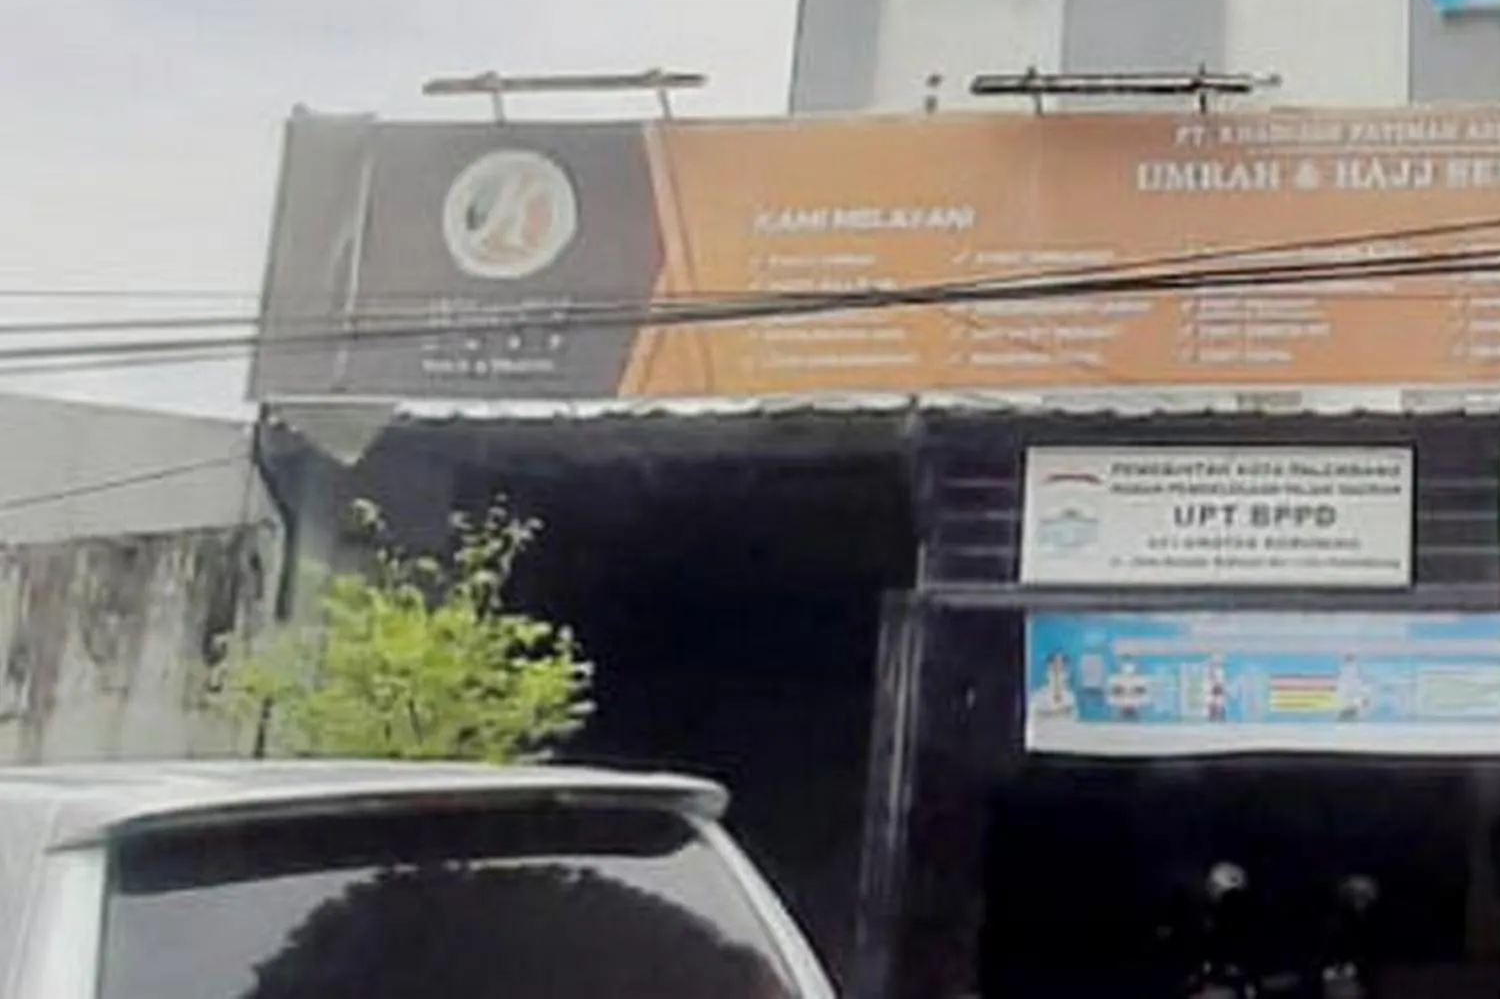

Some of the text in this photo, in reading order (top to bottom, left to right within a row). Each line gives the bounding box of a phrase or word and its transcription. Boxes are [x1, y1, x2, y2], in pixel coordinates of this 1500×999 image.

[1137, 159, 1280, 191] UMRAH
[1336, 155, 1434, 190] HAJJ
[1172, 502, 1338, 529] UPT BPPD
